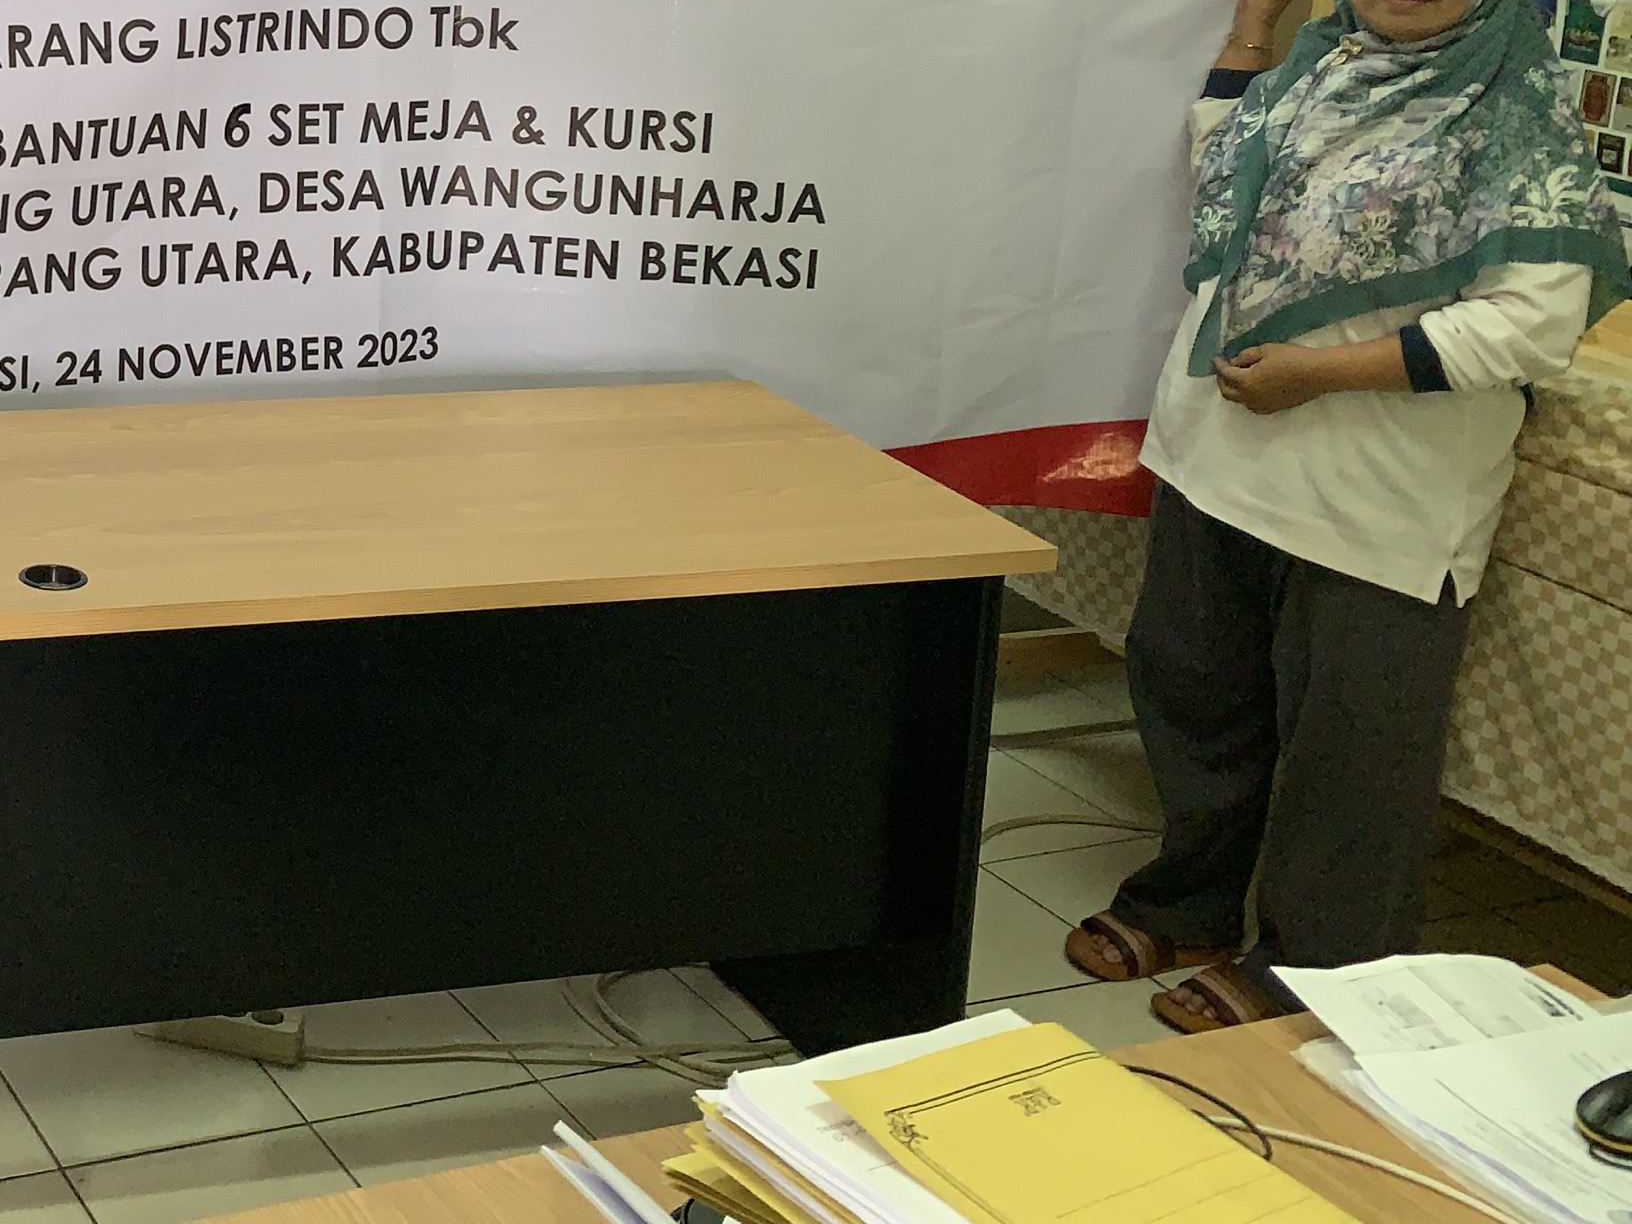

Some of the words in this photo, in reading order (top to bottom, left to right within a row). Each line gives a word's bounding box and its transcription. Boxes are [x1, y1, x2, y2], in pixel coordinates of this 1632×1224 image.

[176, 6, 413, 60] LISTRINDO
[429, 5, 519, 51] Tbk
[224, 102, 252, 148] 6
[267, 102, 344, 147] SET
[359, 99, 492, 144] MEJA
[512, 105, 546, 146] &
[568, 106, 713, 154] KURSI
[71, 174, 239, 226] UTARA,
[259, 169, 385, 214] DESA
[400, 165, 826, 225] WANGUNHARJA
[141, 238, 312, 288] UTARA,
[332, 229, 620, 280] KABUPATEN
[640, 241, 819, 290] BEKASI
[54, 348, 103, 387] 24
[118, 336, 344, 382] NOVEMBER
[356, 326, 439, 369] 2023
